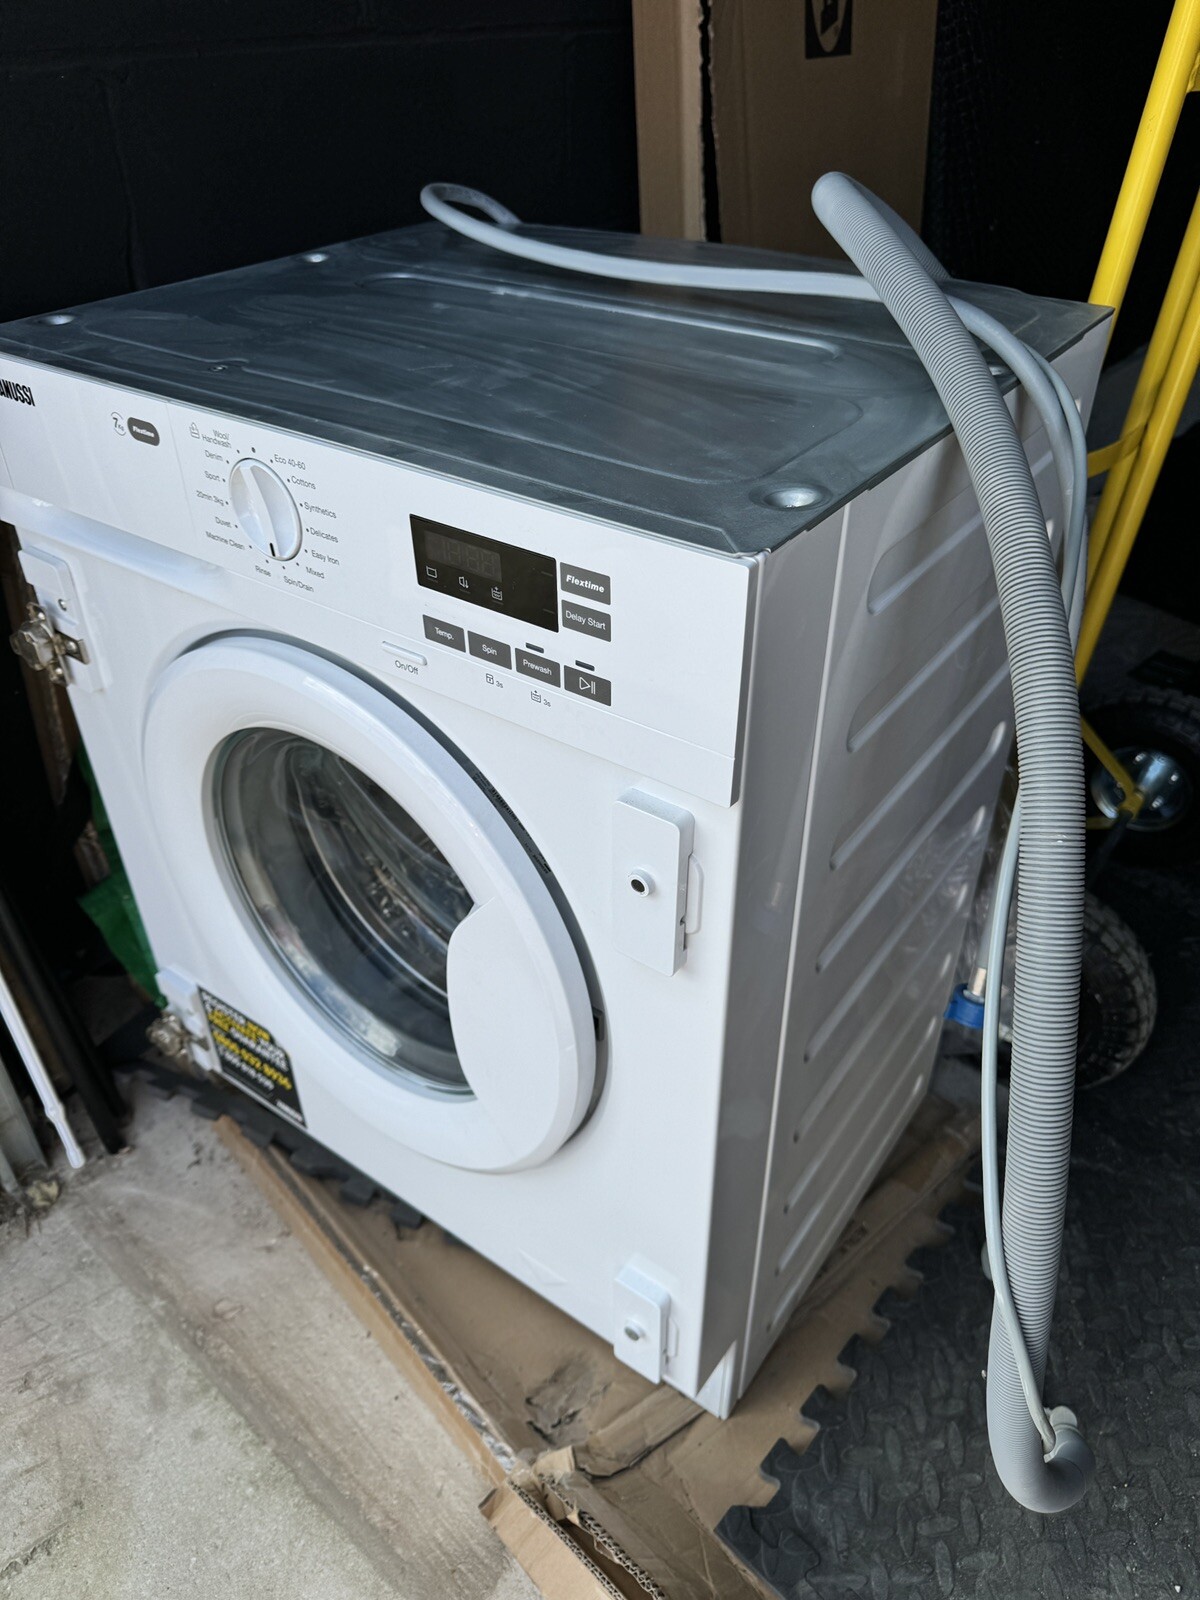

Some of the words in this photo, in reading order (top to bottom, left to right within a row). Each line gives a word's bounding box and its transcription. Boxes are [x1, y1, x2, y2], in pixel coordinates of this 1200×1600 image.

[201, 434, 232, 448] Handwash
[204, 449, 224, 461] Denim
[274, 453, 287, 465] Eco
[287, 458, 306, 470] 40-60
[291, 475, 316, 490] Cottons
[303, 501, 337, 519] Synthetics
[215, 516, 232, 528] Duvet
[205, 530, 229, 545] Machine
[229, 539, 246, 551] Clean
[309, 526, 339, 543] Delicates
[311, 549, 327, 563] Easy
[327, 555, 340, 566] Iron
[255, 565, 272, 578] Rinse
[305, 566, 325, 579] Mixed
[283, 575, 315, 593] Spin/Drain
[565, 574, 605, 593] Flextime
[565, 610, 587, 625] Delay
[587, 617, 606, 631] Start
[434, 626, 455, 641] Temp.
[481, 644, 498, 656] Spin
[394, 659, 419, 675] On/Off
[522, 658, 553, 676] Prewash
[495, 680, 504, 689] 3s
